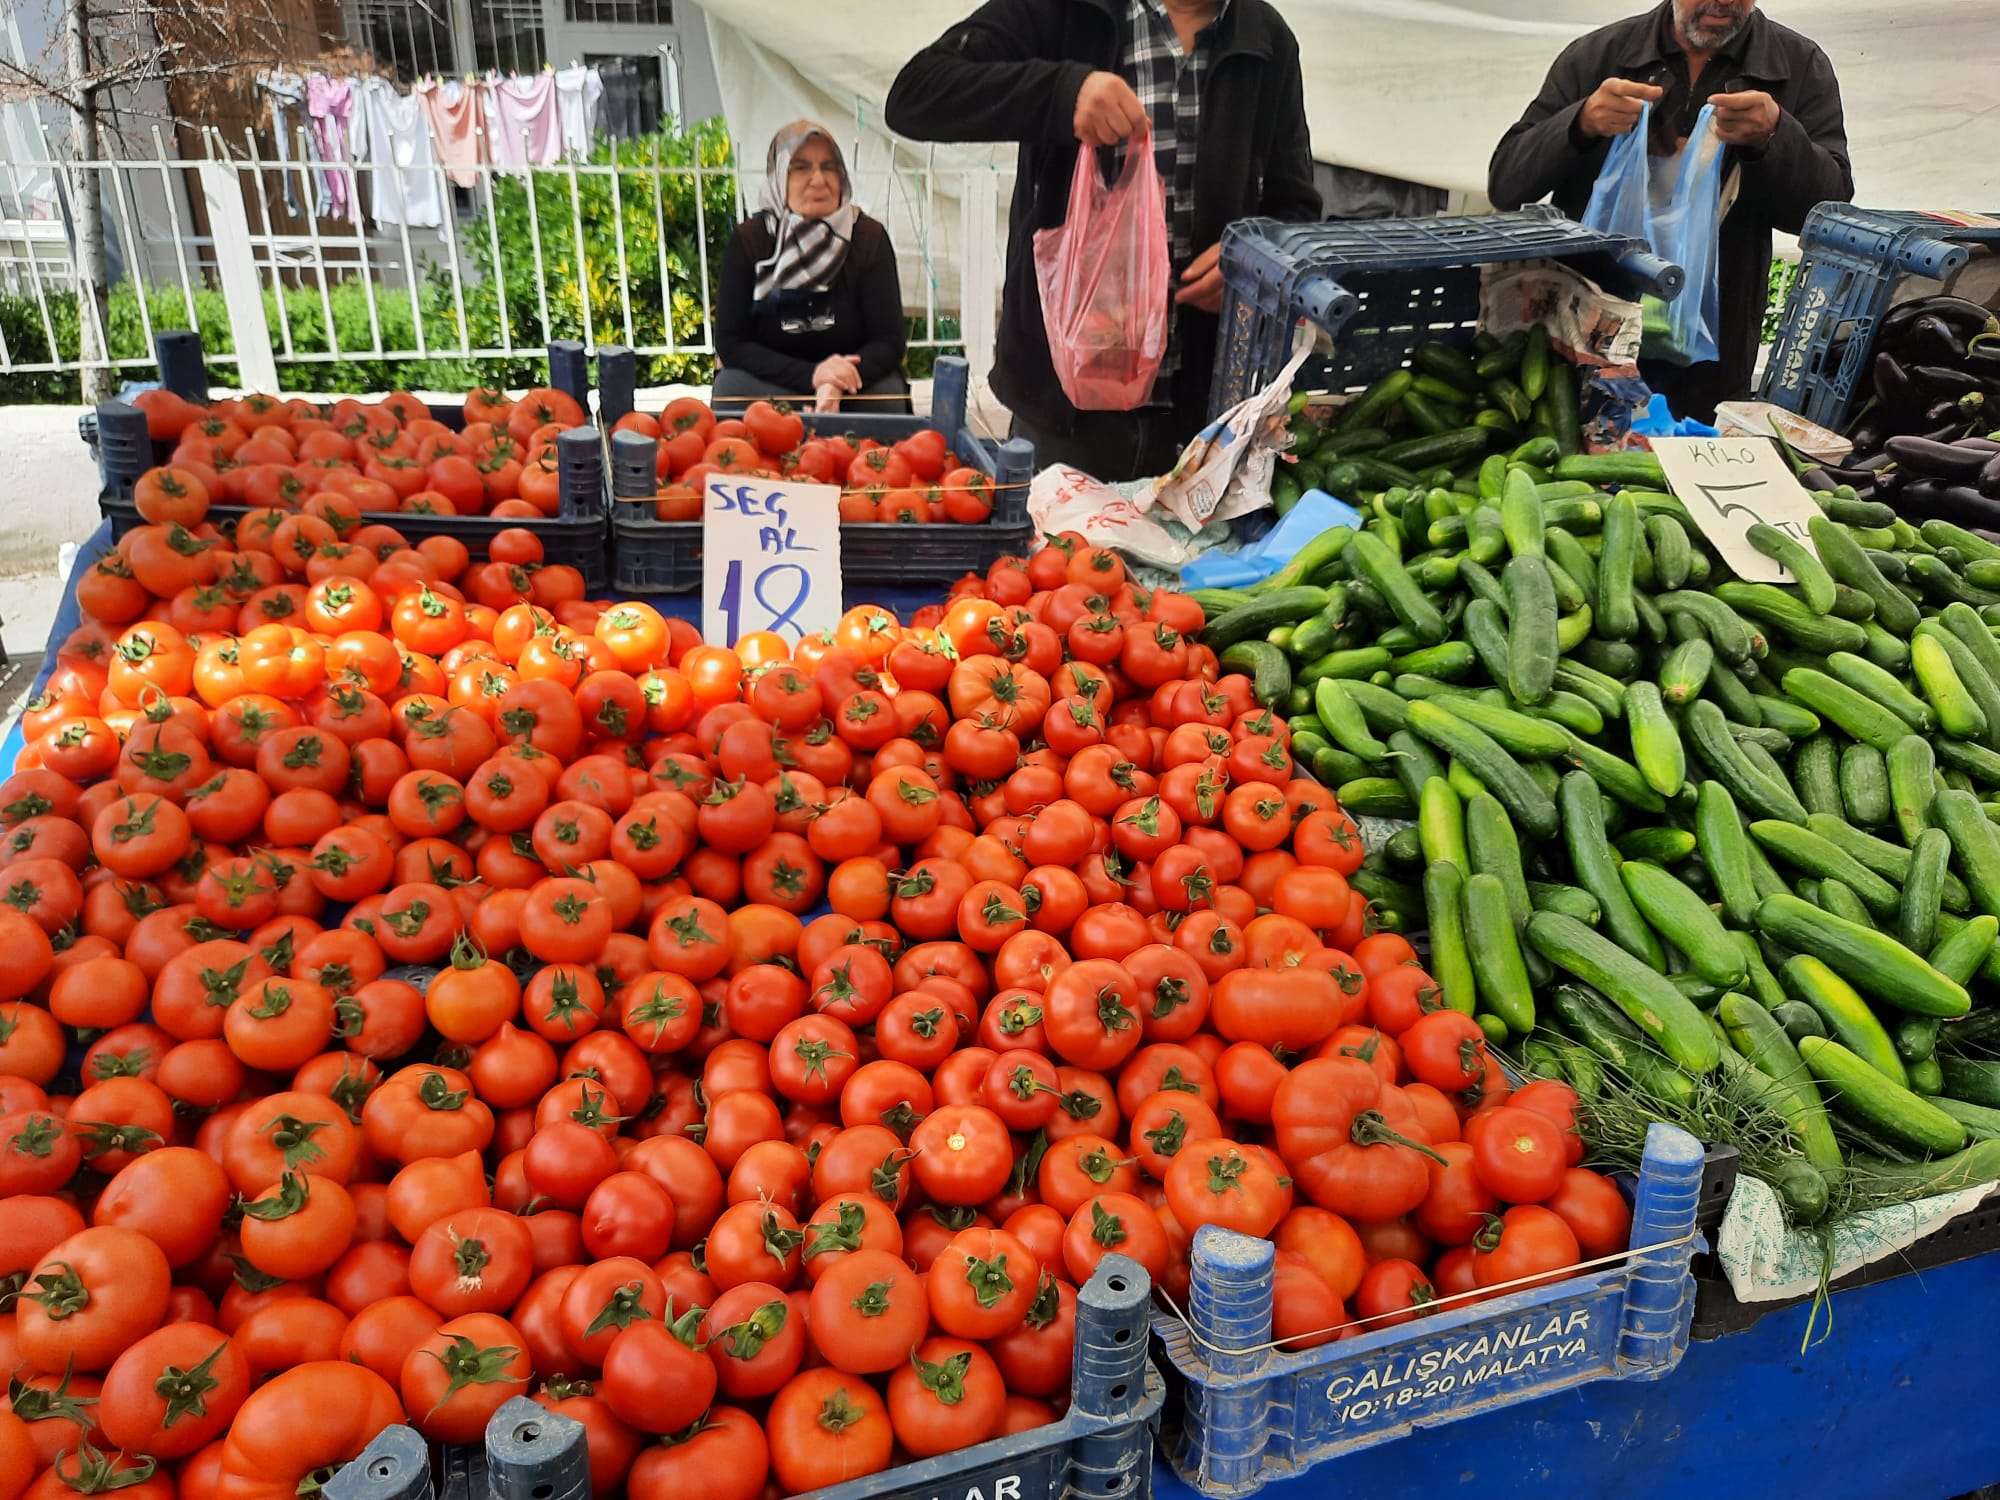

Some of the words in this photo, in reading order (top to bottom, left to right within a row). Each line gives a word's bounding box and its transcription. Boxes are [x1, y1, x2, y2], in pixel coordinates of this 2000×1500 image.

[1787, 286, 1826, 390] ADNAN
[759, 526, 819, 555] AL
[1694, 480, 1785, 576] 5
[1326, 1309, 1591, 1405] ÇALIŞKANLAR
[1461, 1337, 1587, 1387] MALATYA
